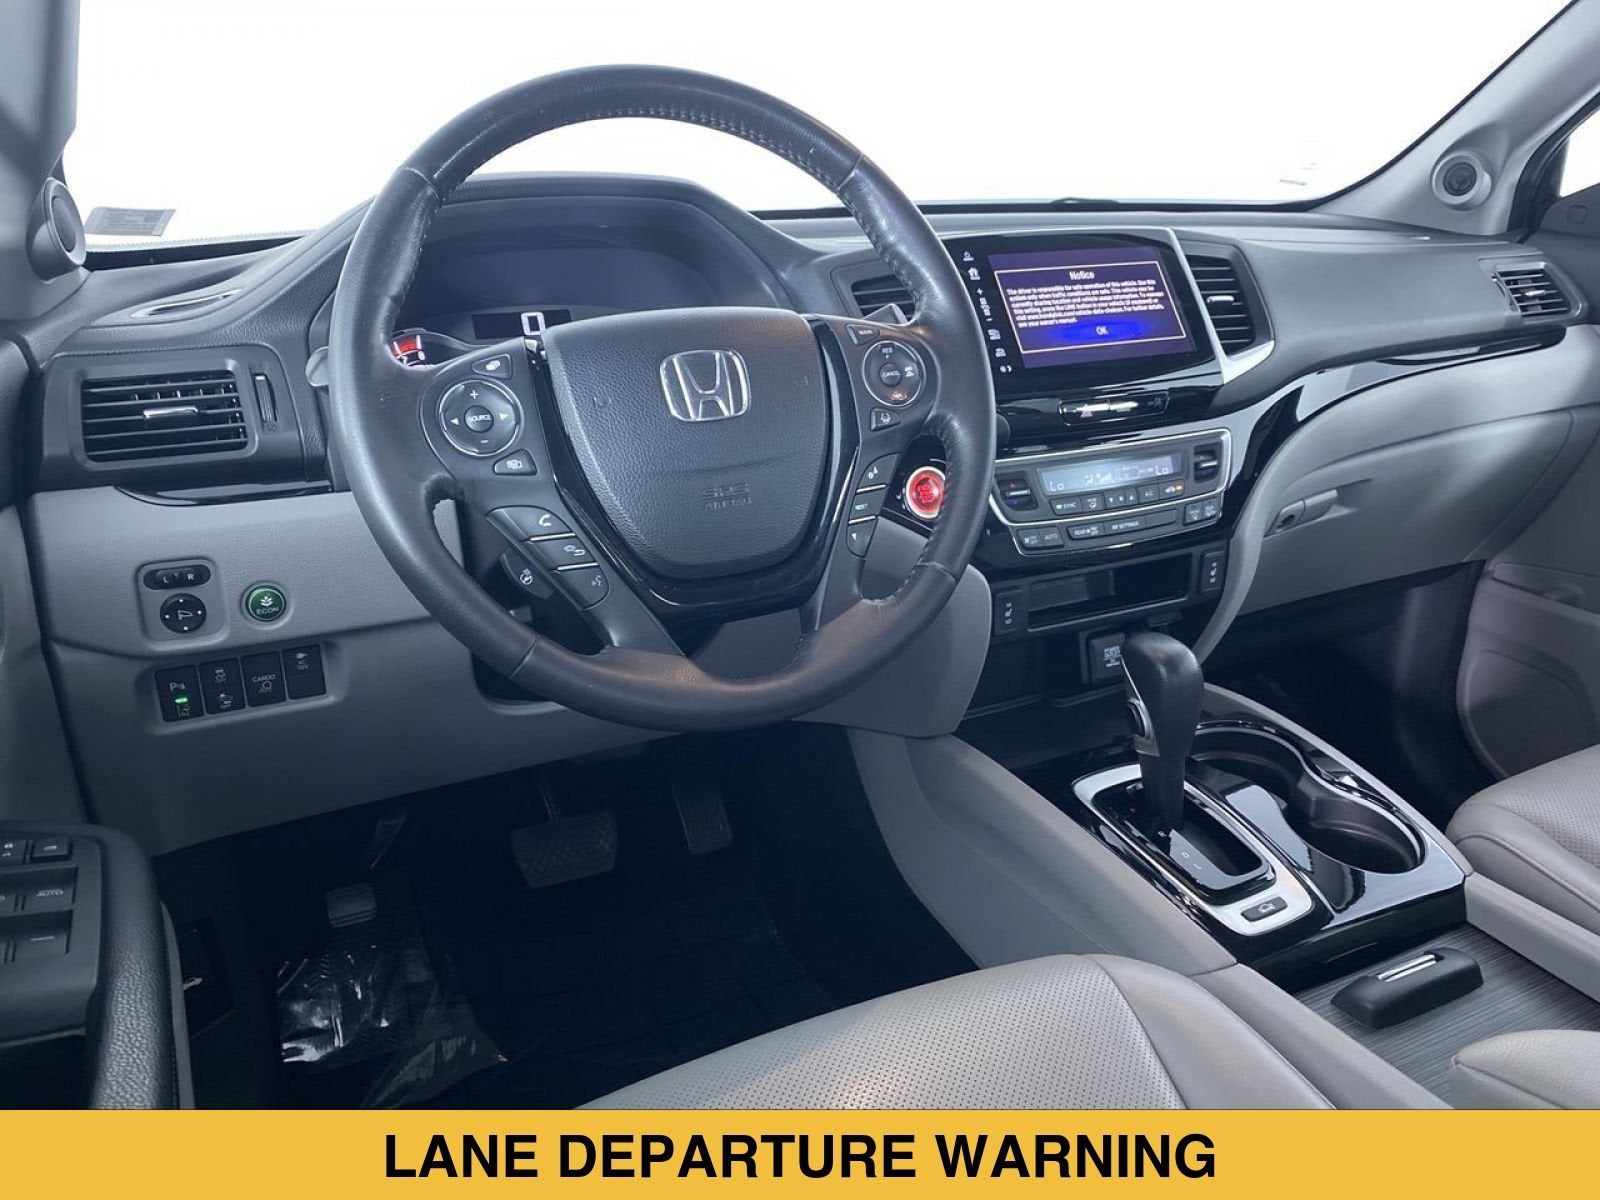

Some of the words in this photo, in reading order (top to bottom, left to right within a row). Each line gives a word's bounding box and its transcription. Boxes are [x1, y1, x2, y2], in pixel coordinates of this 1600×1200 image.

[1069, 270, 1095, 280] Notice
[1096, 326, 1109, 335] OK
[469, 414, 492, 422] SOURCE
[163, 576, 169, 584] L
[187, 573, 194, 581] R
[256, 606, 280, 616] ECON
